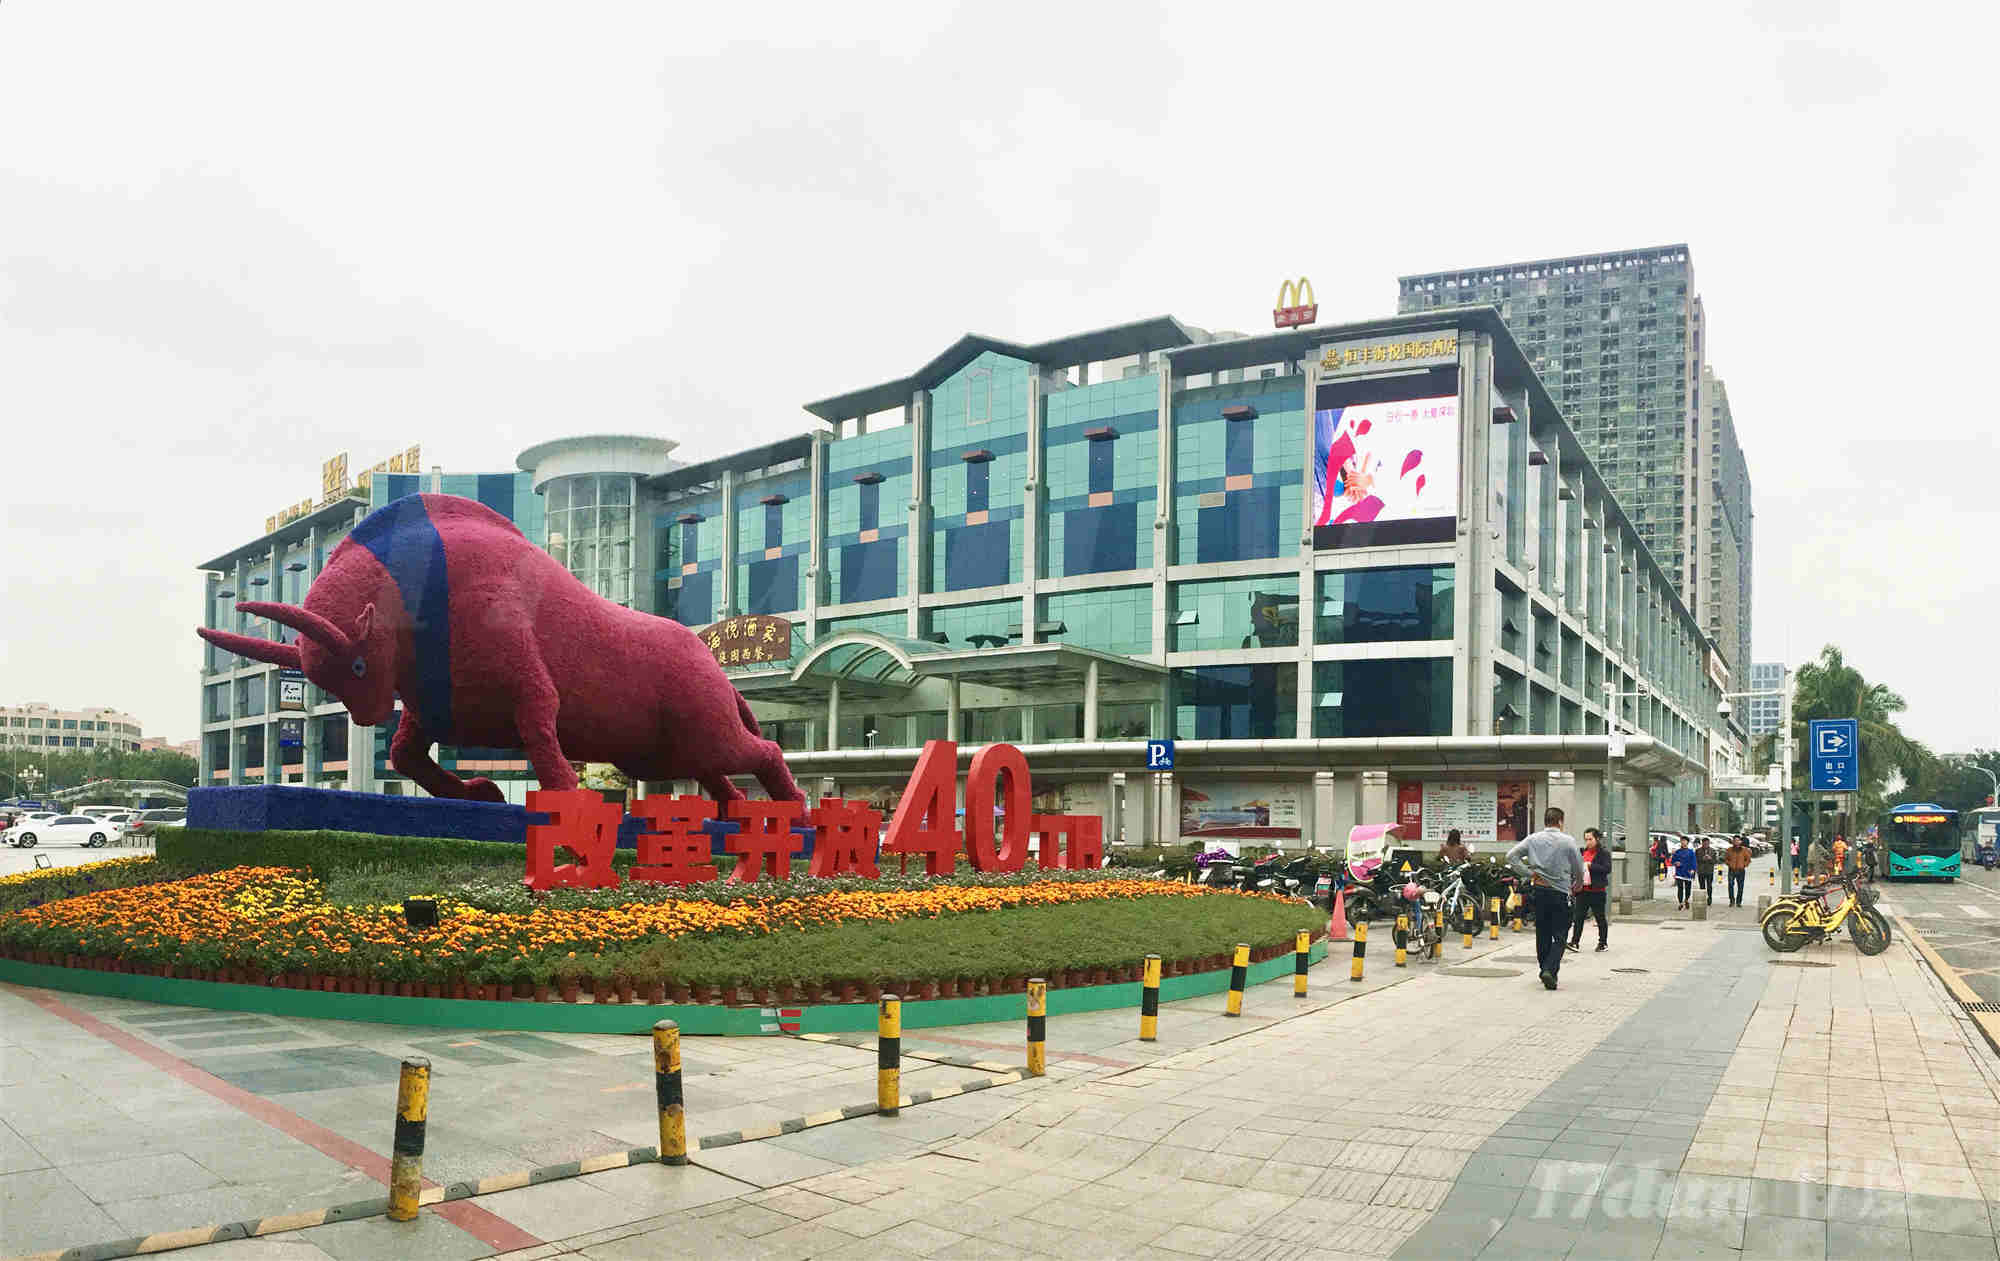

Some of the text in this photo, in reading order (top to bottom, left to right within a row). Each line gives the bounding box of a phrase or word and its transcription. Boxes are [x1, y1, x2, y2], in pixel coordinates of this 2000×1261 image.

[1150, 744, 1166, 766] P
[1825, 760, 1845, 769] 出口
[524, 790, 882, 890] 改革开放
